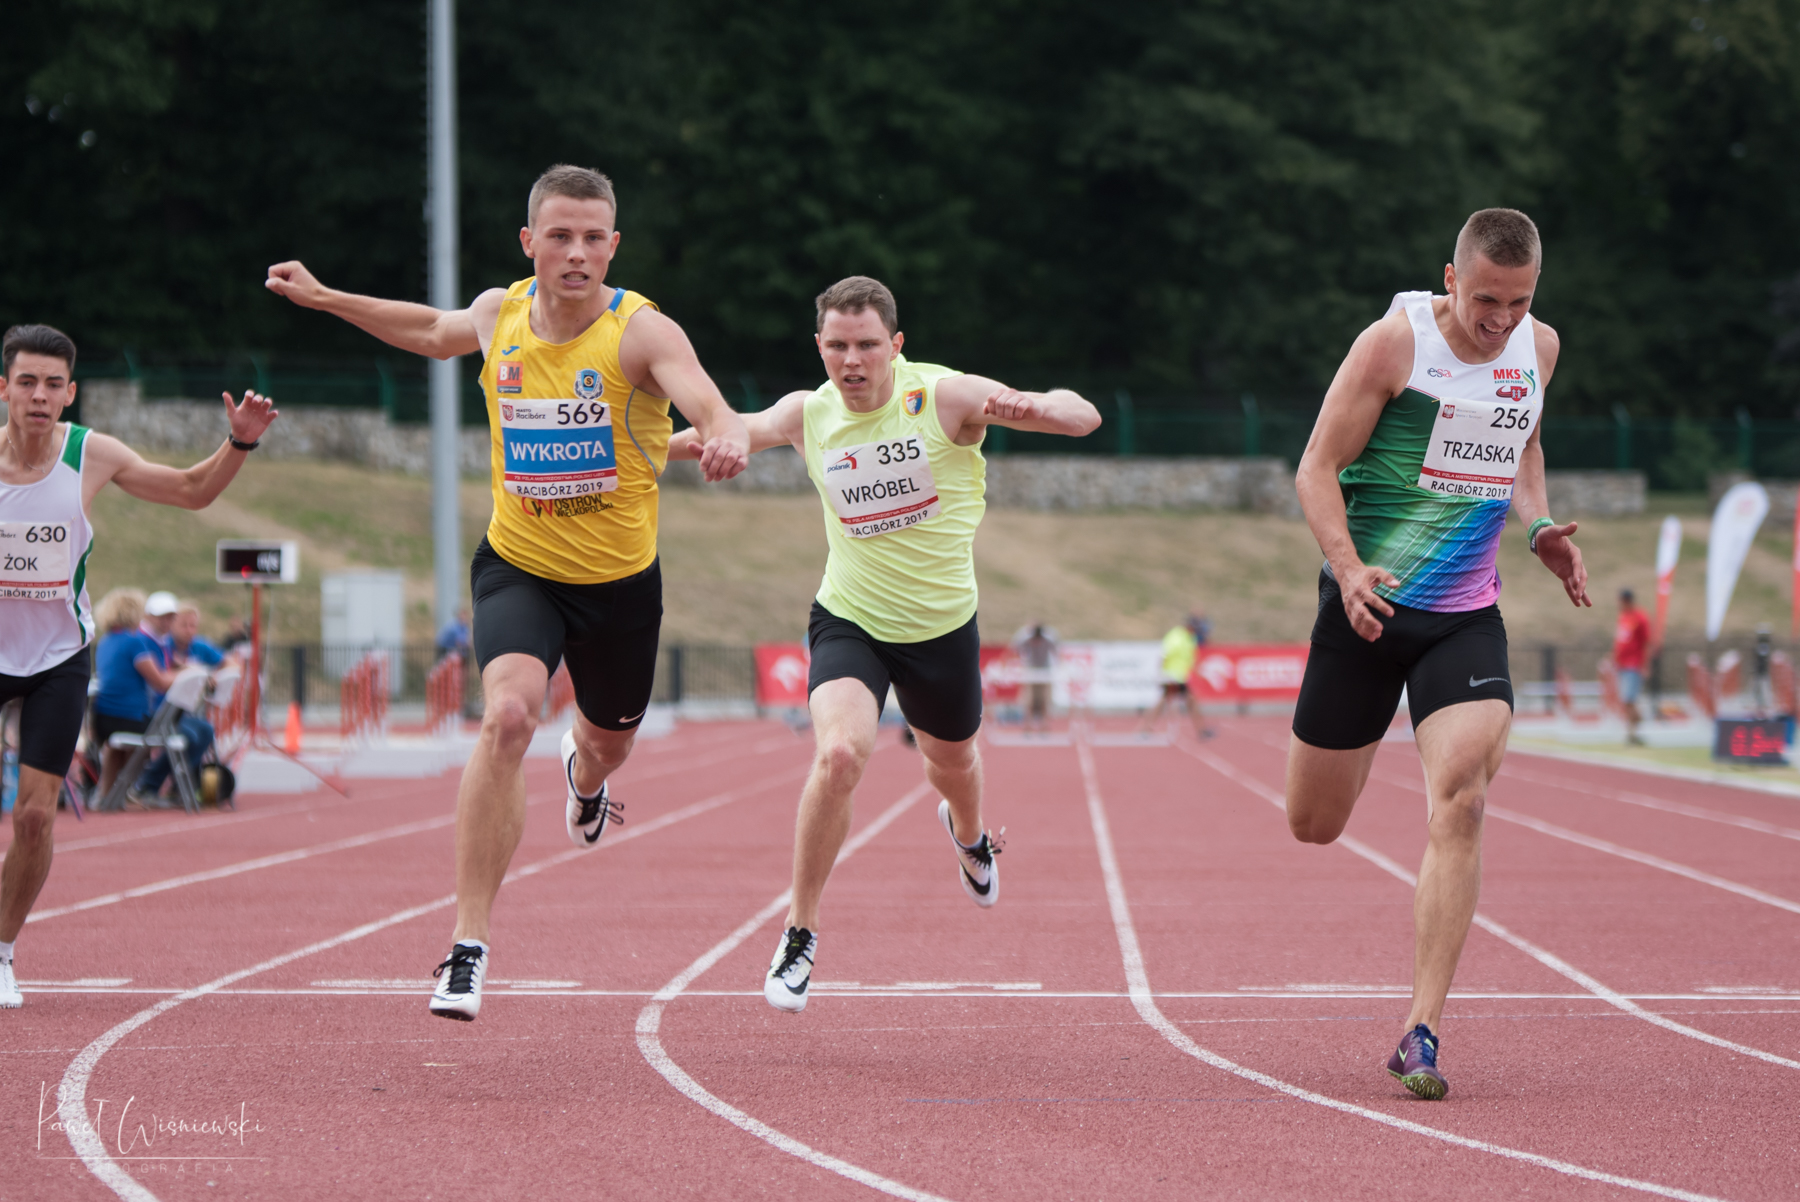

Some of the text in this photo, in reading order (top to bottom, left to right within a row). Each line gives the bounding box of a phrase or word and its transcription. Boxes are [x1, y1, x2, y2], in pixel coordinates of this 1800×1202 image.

[499, 365, 520, 381] BM
[1493, 368, 1521, 380] MKS
[516, 412, 546, 420] Racibórz
[557, 403, 605, 426] 569
[1490, 407, 1530, 430] 256
[510, 440, 607, 461] WYKROTA
[876, 439, 920, 465] 335
[1443, 440, 1515, 464] TRZASKA
[827, 462, 851, 473] polanik
[516, 481, 603, 496] RACIBÓRZ 2019
[842, 477, 920, 505] WRÓBEL
[1431, 480, 1507, 498] RACIBÓRZ 2019
[554, 502, 614, 518] WIELKOPOLSKI
[904, 509, 928, 526] 2019
[25, 526, 66, 543] 630
[4, 553, 38, 571] ŻOK
[34, 590, 57, 599] 2019
